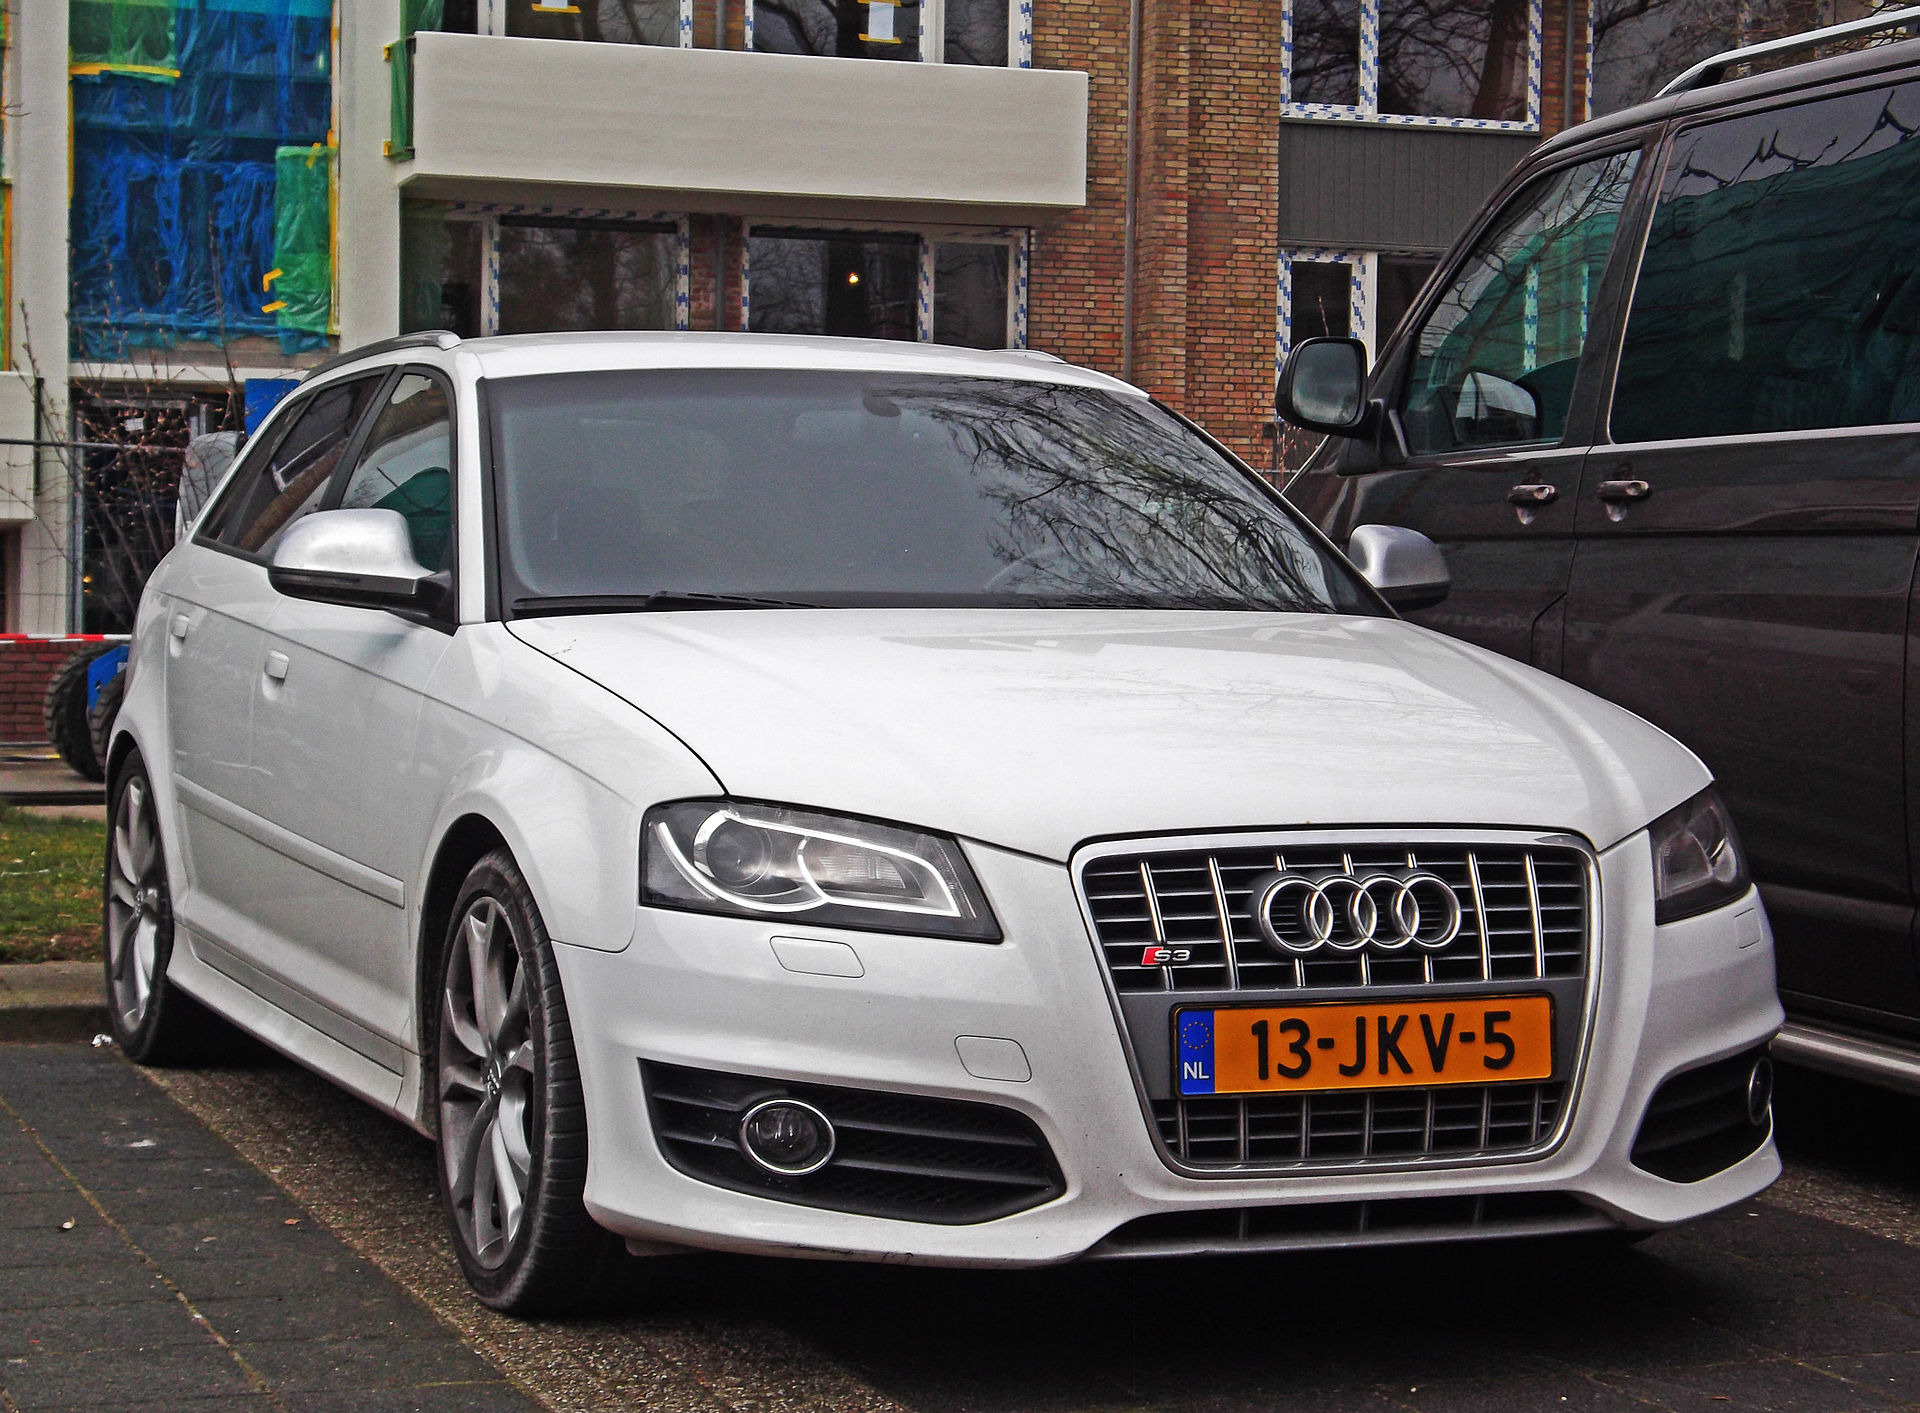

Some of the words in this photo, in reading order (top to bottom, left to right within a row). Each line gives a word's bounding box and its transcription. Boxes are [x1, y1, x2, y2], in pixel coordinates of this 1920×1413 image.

[1153, 948, 1191, 963] S3
[1250, 1010, 1515, 1080] 13-JKV-5
[1182, 1060, 1210, 1080] NL
